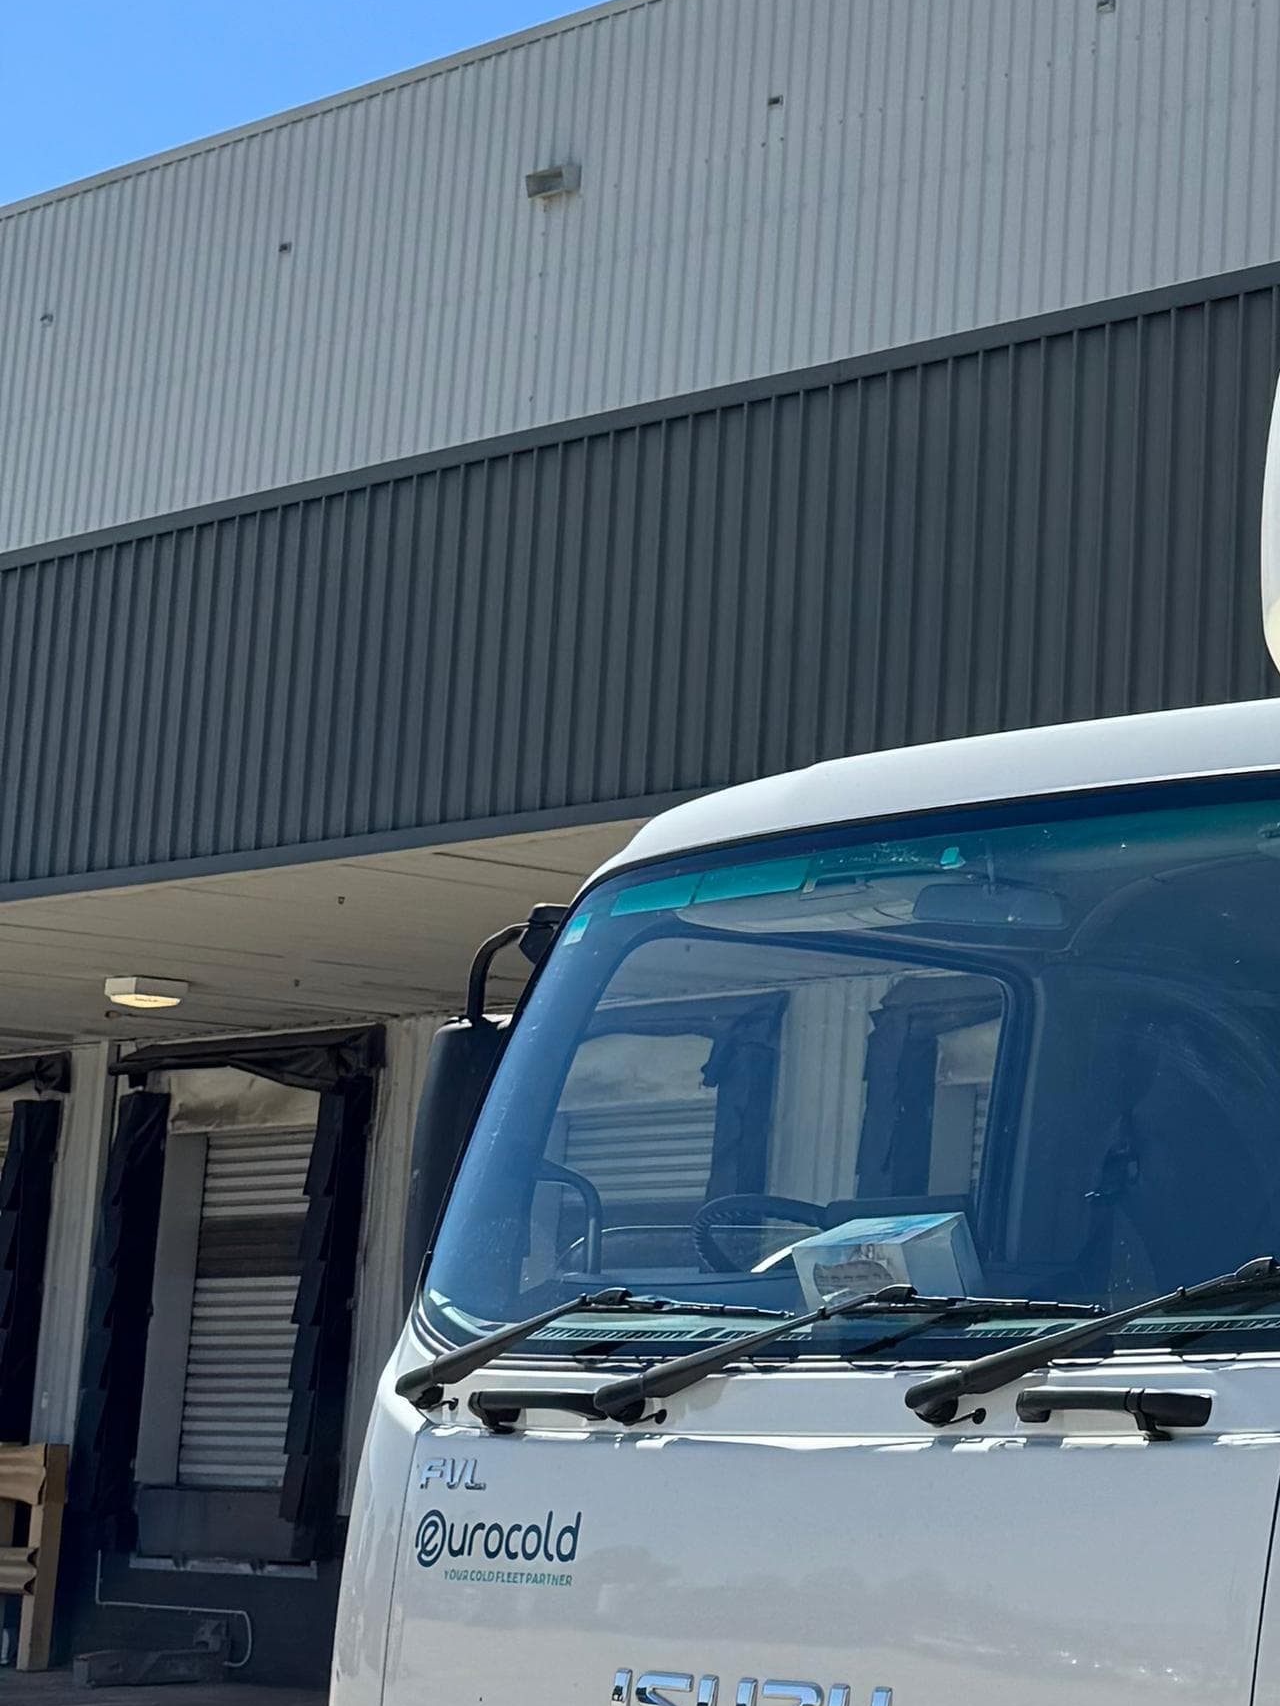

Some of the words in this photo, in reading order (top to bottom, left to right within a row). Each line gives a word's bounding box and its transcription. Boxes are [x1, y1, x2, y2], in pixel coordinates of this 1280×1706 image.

[419, 1457, 487, 1491] FVL
[415, 1509, 582, 1568] eurocold
[469, 1570, 495, 1583] COLD
[495, 1571, 526, 1584] FLEET
[525, 1573, 573, 1587] PARTNER
